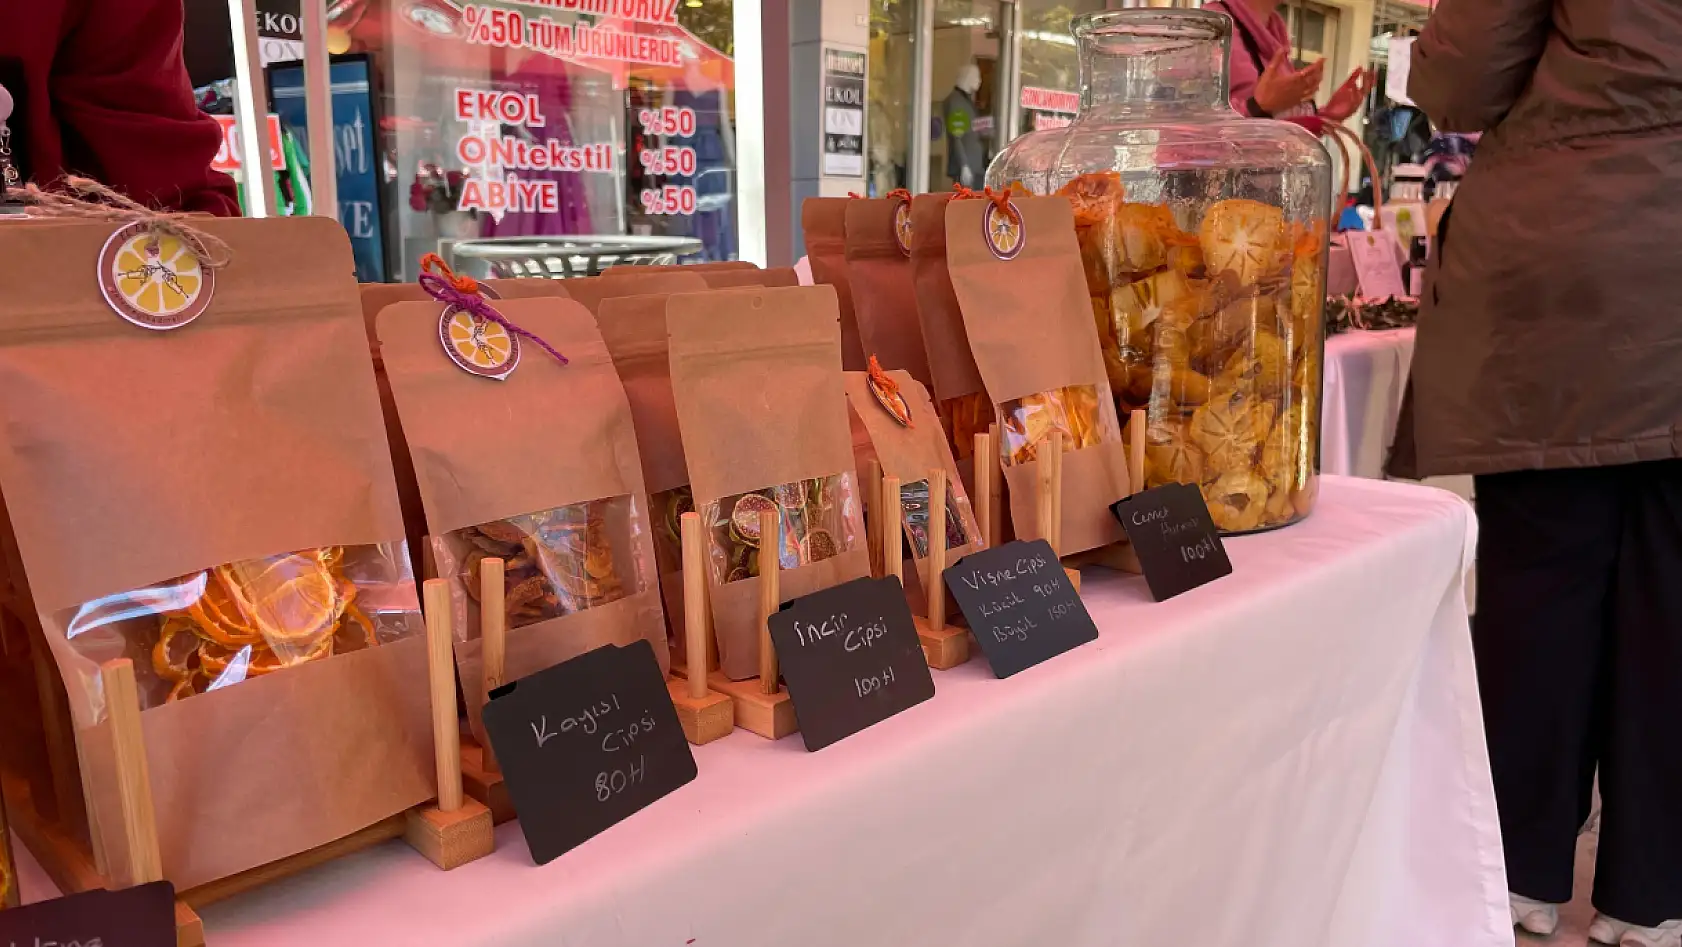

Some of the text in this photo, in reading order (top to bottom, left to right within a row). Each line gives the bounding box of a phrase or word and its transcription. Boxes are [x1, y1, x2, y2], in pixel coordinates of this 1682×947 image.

[465, 6, 523, 46] %50
[577, 22, 682, 64] ÜRÜNLERDE
[457, 90, 695, 136] EKOL %50
[458, 136, 696, 176] ONtekstil %50
[460, 175, 696, 214] ABİYE %50
